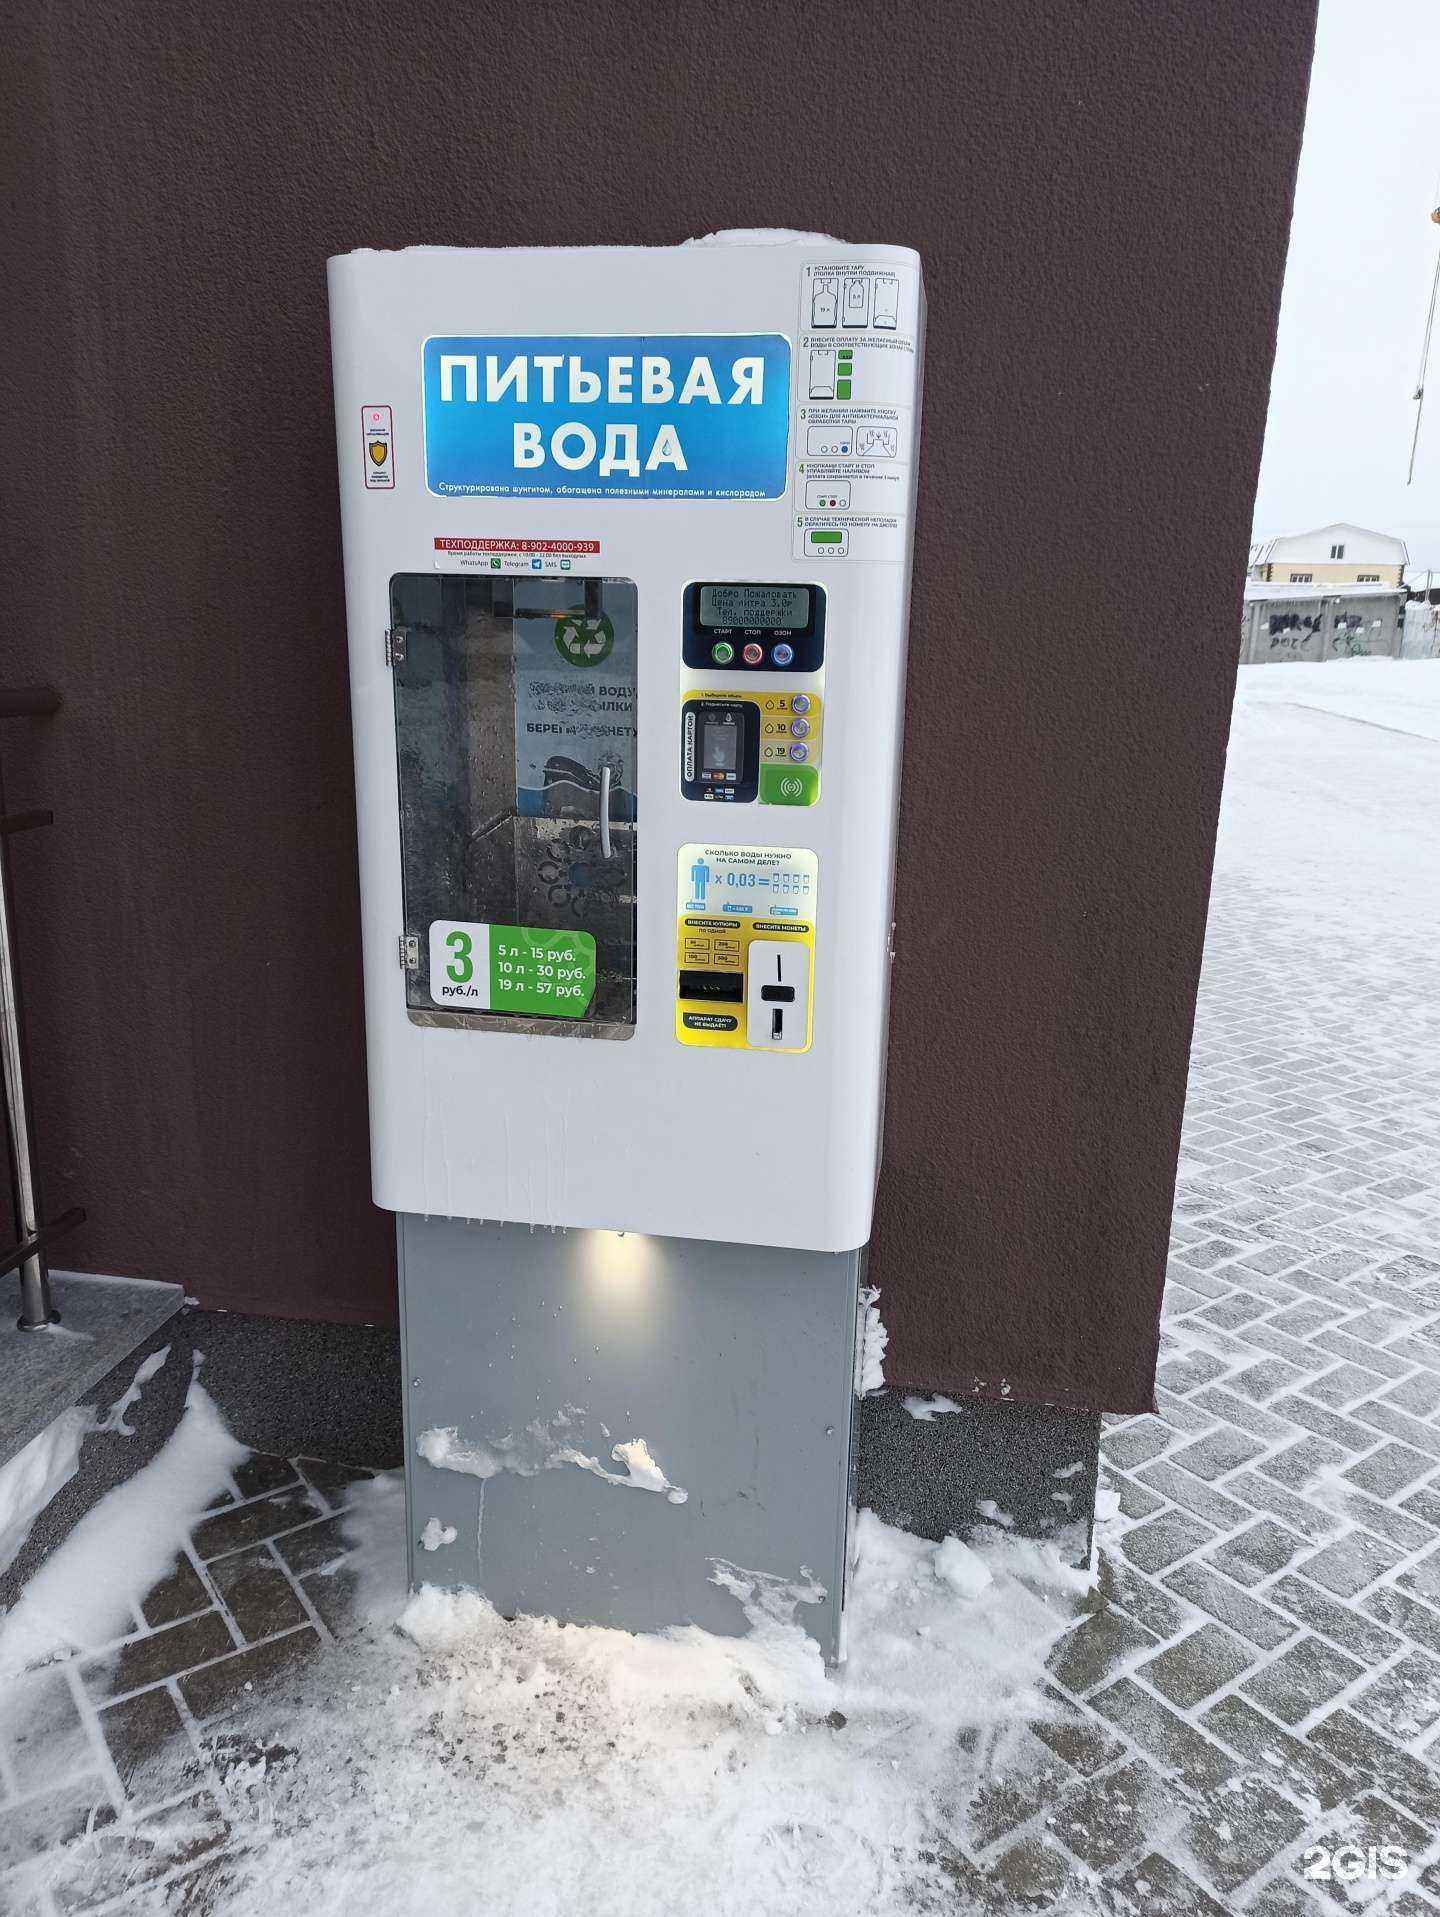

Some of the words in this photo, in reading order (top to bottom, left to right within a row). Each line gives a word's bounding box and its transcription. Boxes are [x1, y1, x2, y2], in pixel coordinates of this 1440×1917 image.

[803, 336, 809, 347] 2
[440, 354, 765, 405] ПИТЬЕВАЯ
[801, 409, 806, 420] 3
[513, 422, 688, 478] ВОДА
[799, 464, 804, 474] 4
[438, 482, 510, 494] Структурирована
[512, 486, 553, 495] шунгитом,
[556, 486, 602, 495] обогащена
[605, 488, 649, 496] полезными
[652, 488, 705, 497] минералами
[715, 488, 766, 498] кислородом
[797, 517, 803, 528] 5
[439, 539, 520, 550] ТЕХПОДДЕРЖКА:
[521, 541, 594, 552] 8-902-4000-939
[460, 559, 489, 567] WhatsApp
[503, 560, 529, 568] Telegram
[712, 588, 739, 598] Добро
[744, 588, 797, 599] Пожаловать
[711, 597, 734, 607] Цена
[741, 599, 766, 607] литра
[717, 607, 737, 616] Тел.
[743, 608, 793, 617] поддержки
[779, 699, 786, 708] 5
[777, 723, 786, 731] 10
[776, 747, 786, 755] 19
[704, 849, 740, 857] СКОЛЬКО
[740, 851, 763, 859] ВОДЫ
[764, 852, 792, 860] НУЖНО
[727, 872, 756, 888] 0,03
[446, 931, 474, 983] 3
[498, 944, 507, 956] 5
[509, 947, 519, 957] л
[530, 947, 544, 959] 15
[547, 949, 576, 963] руб.
[498, 962, 513, 973] 10
[516, 965, 525, 974] л
[536, 964, 554, 976] 30
[557, 967, 586, 981] руб.
[442, 985, 479, 997] руб./л
[498, 979, 512, 991] 19
[515, 982, 524, 992] л
[536, 982, 552, 994] 57
[555, 984, 585, 998] руб.
